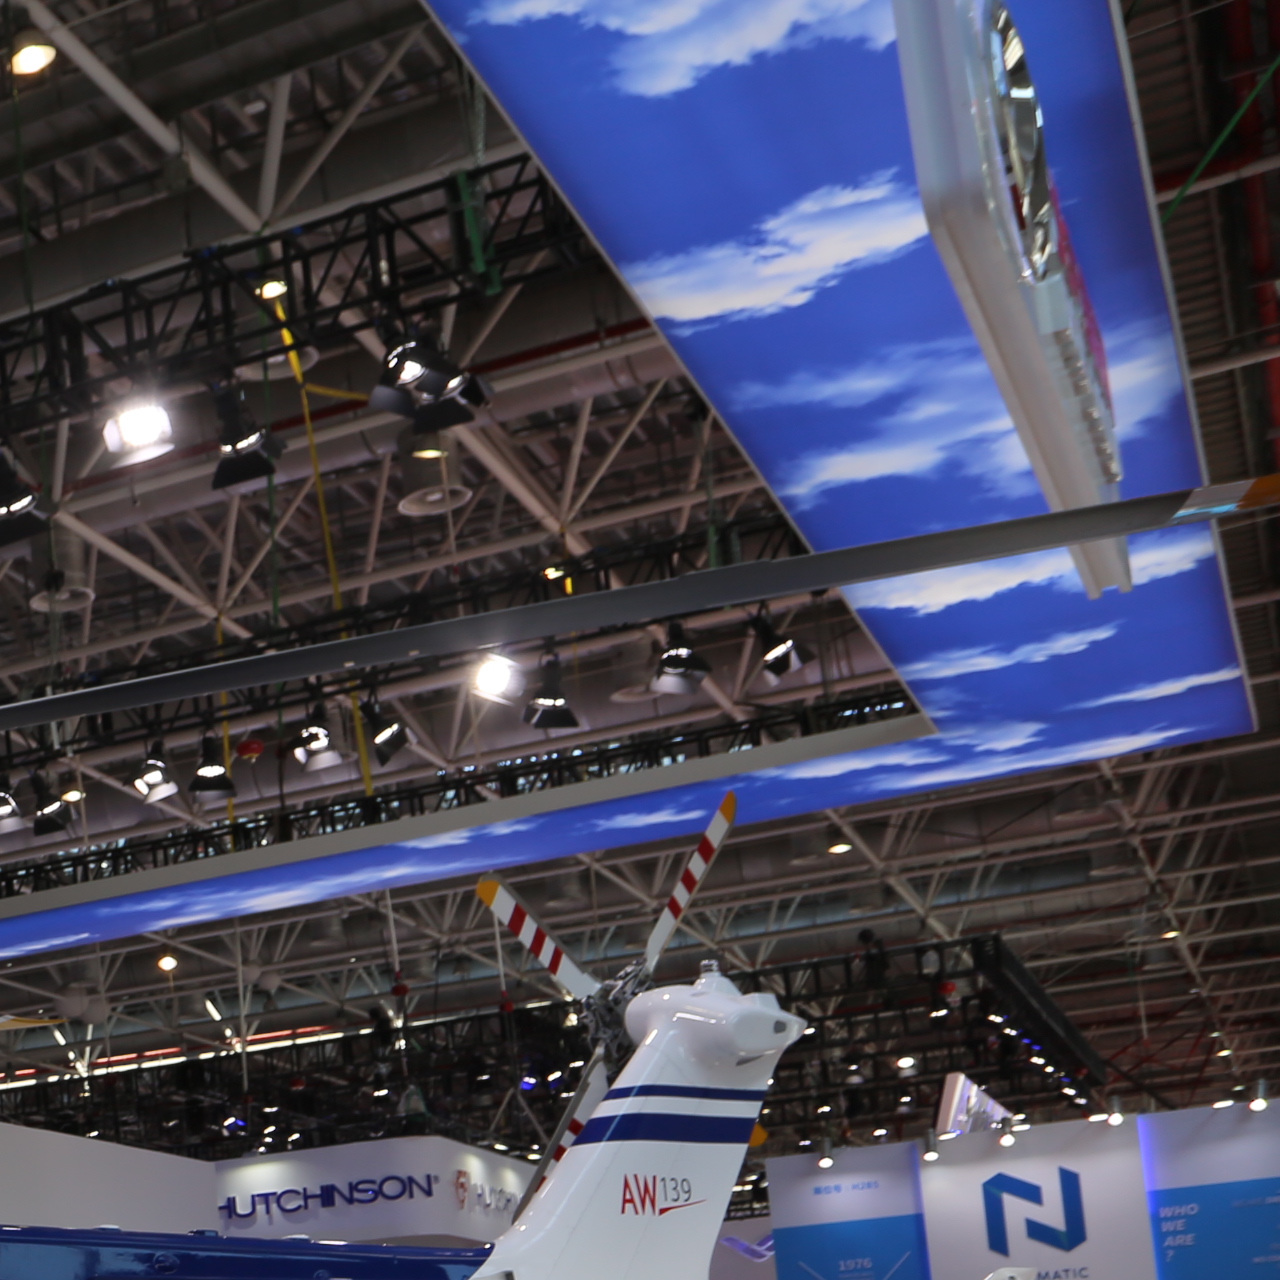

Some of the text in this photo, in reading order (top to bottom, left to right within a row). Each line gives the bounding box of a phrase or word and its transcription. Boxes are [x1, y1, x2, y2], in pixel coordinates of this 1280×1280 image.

[1158, 1203, 1200, 1218] WHO
[1160, 1219, 1187, 1232] WE
[1162, 1233, 1196, 1248] ARE
